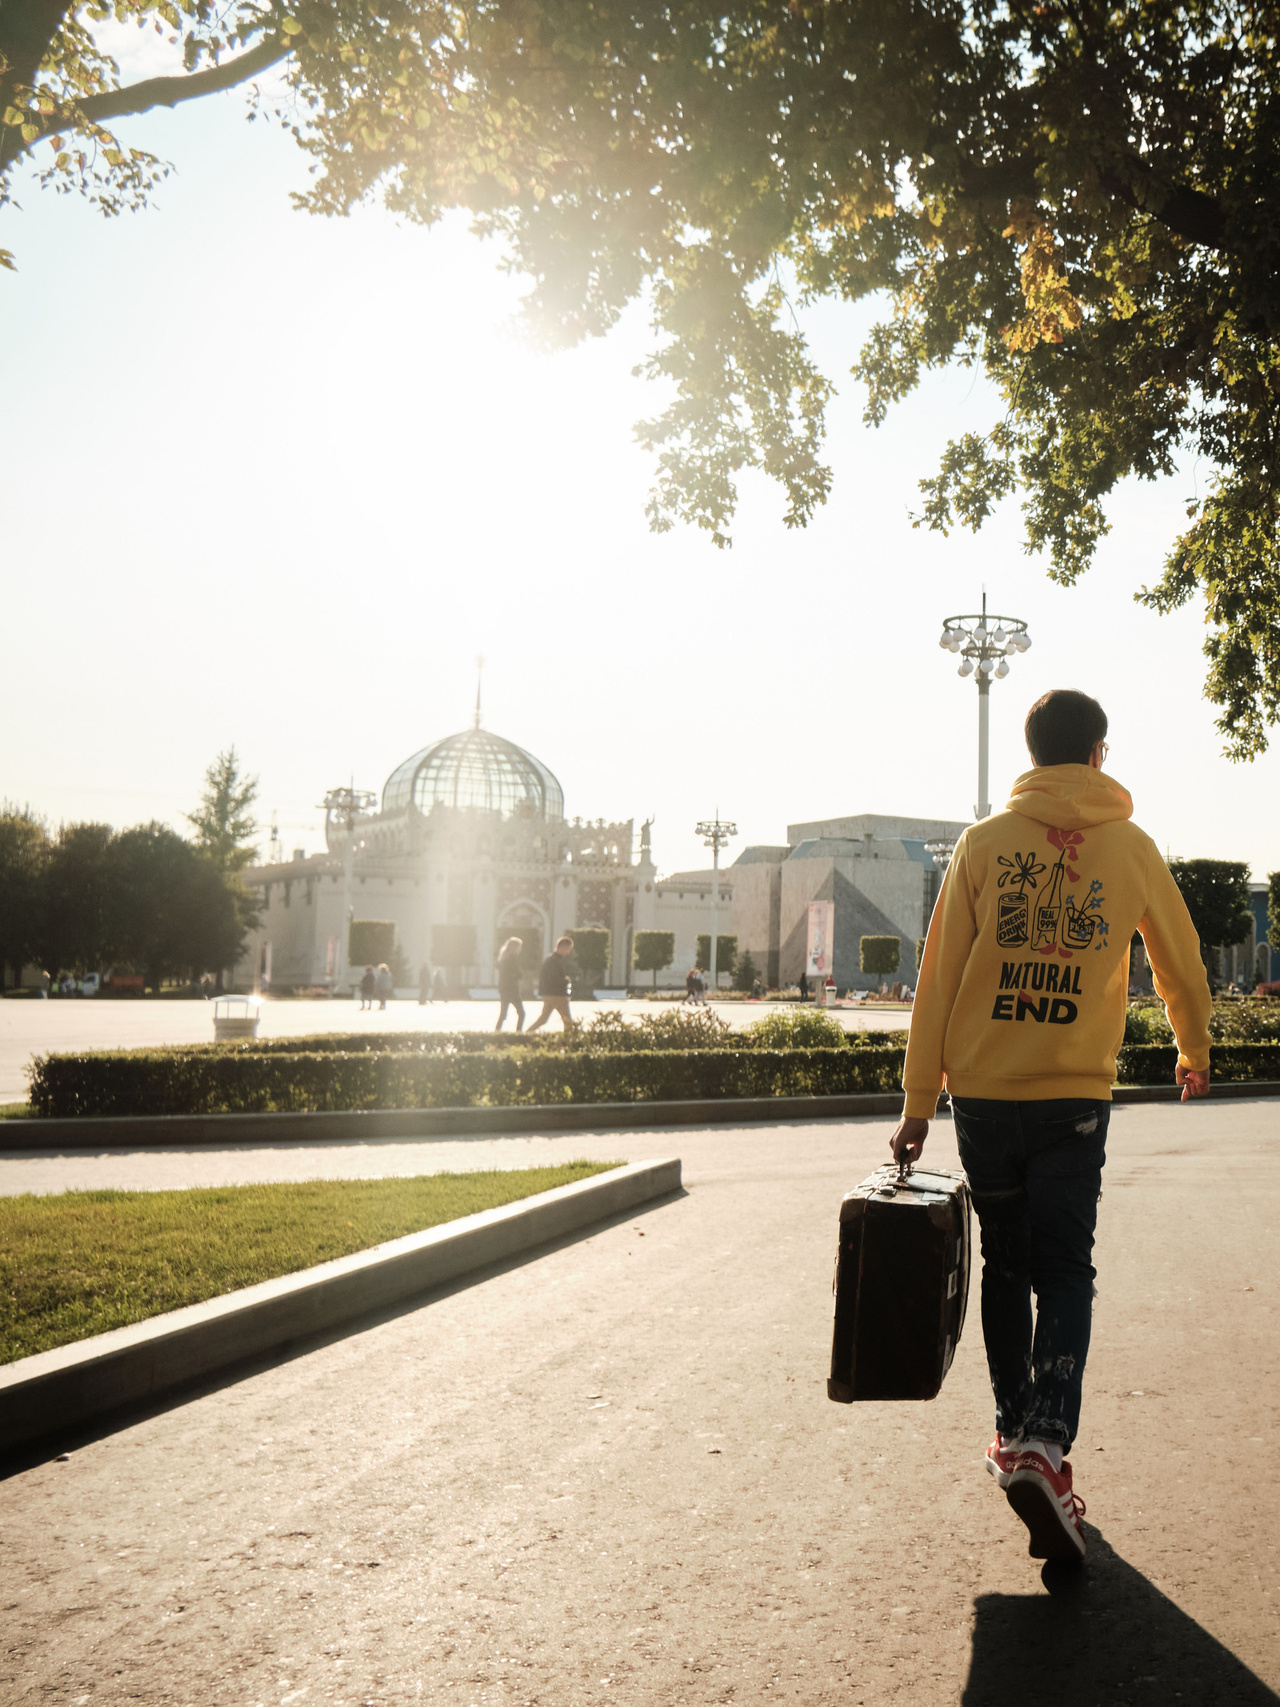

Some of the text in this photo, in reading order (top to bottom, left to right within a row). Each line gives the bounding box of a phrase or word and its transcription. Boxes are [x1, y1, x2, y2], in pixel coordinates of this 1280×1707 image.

[999, 908, 1026, 932] ENERG
[1041, 910, 1054, 919] REAL
[1069, 921, 1094, 934] FRSH
[999, 962, 1082, 995] NATURAL
[991, 994, 1078, 1024] END
